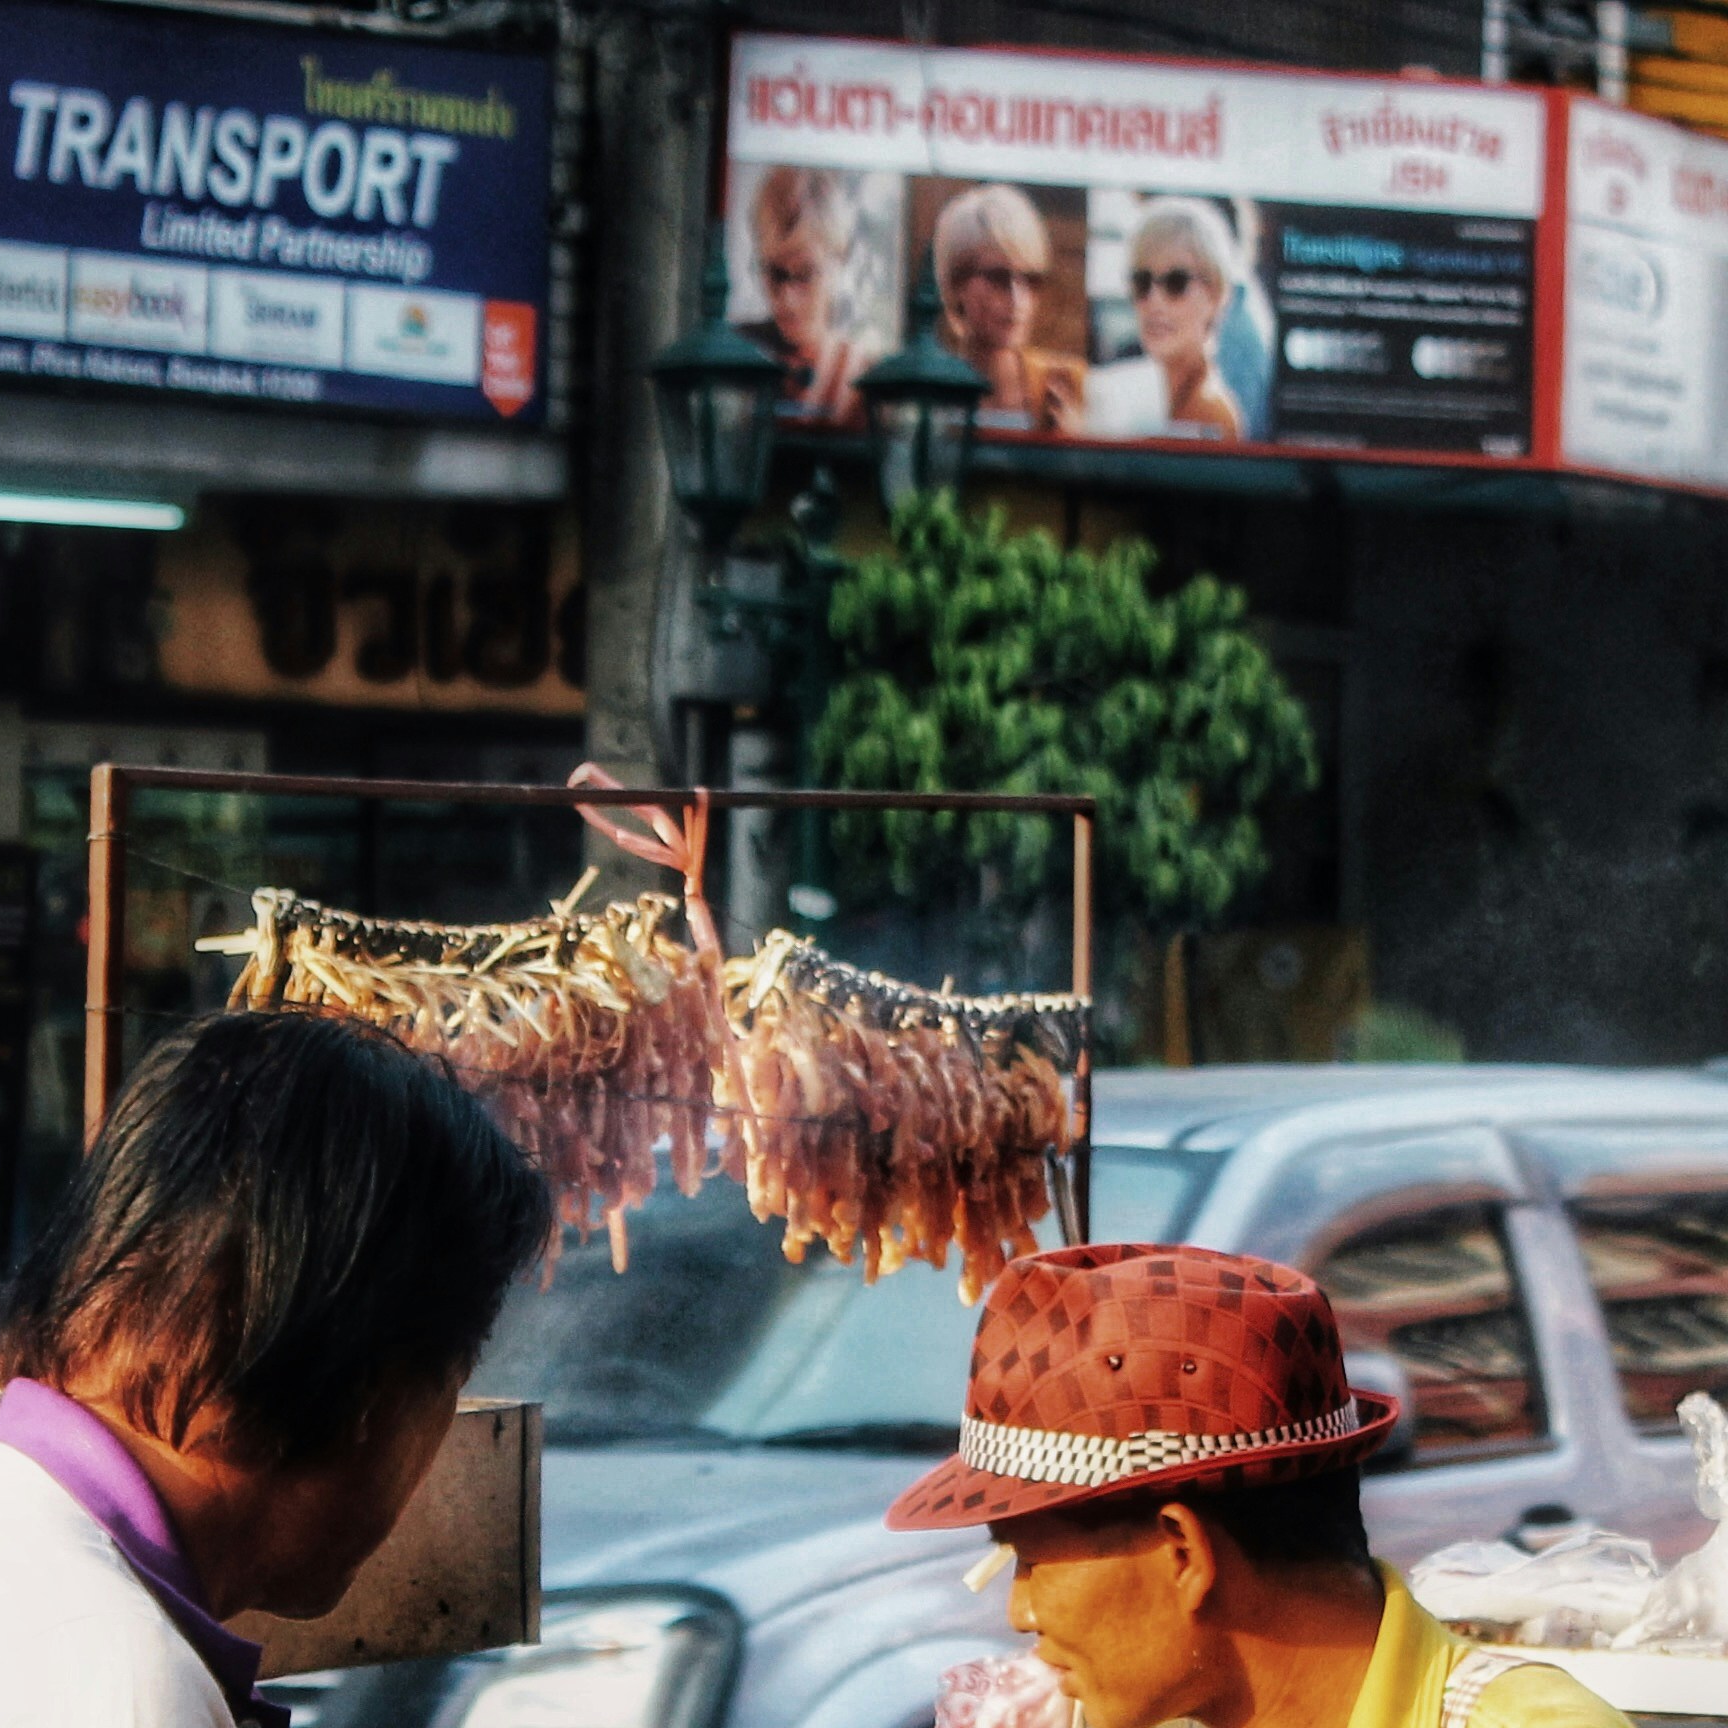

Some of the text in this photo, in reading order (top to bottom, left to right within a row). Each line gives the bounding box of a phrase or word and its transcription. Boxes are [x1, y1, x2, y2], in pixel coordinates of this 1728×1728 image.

[9, 78, 460, 228] TRANSPORT
[140, 200, 433, 284] Limited Partnership
